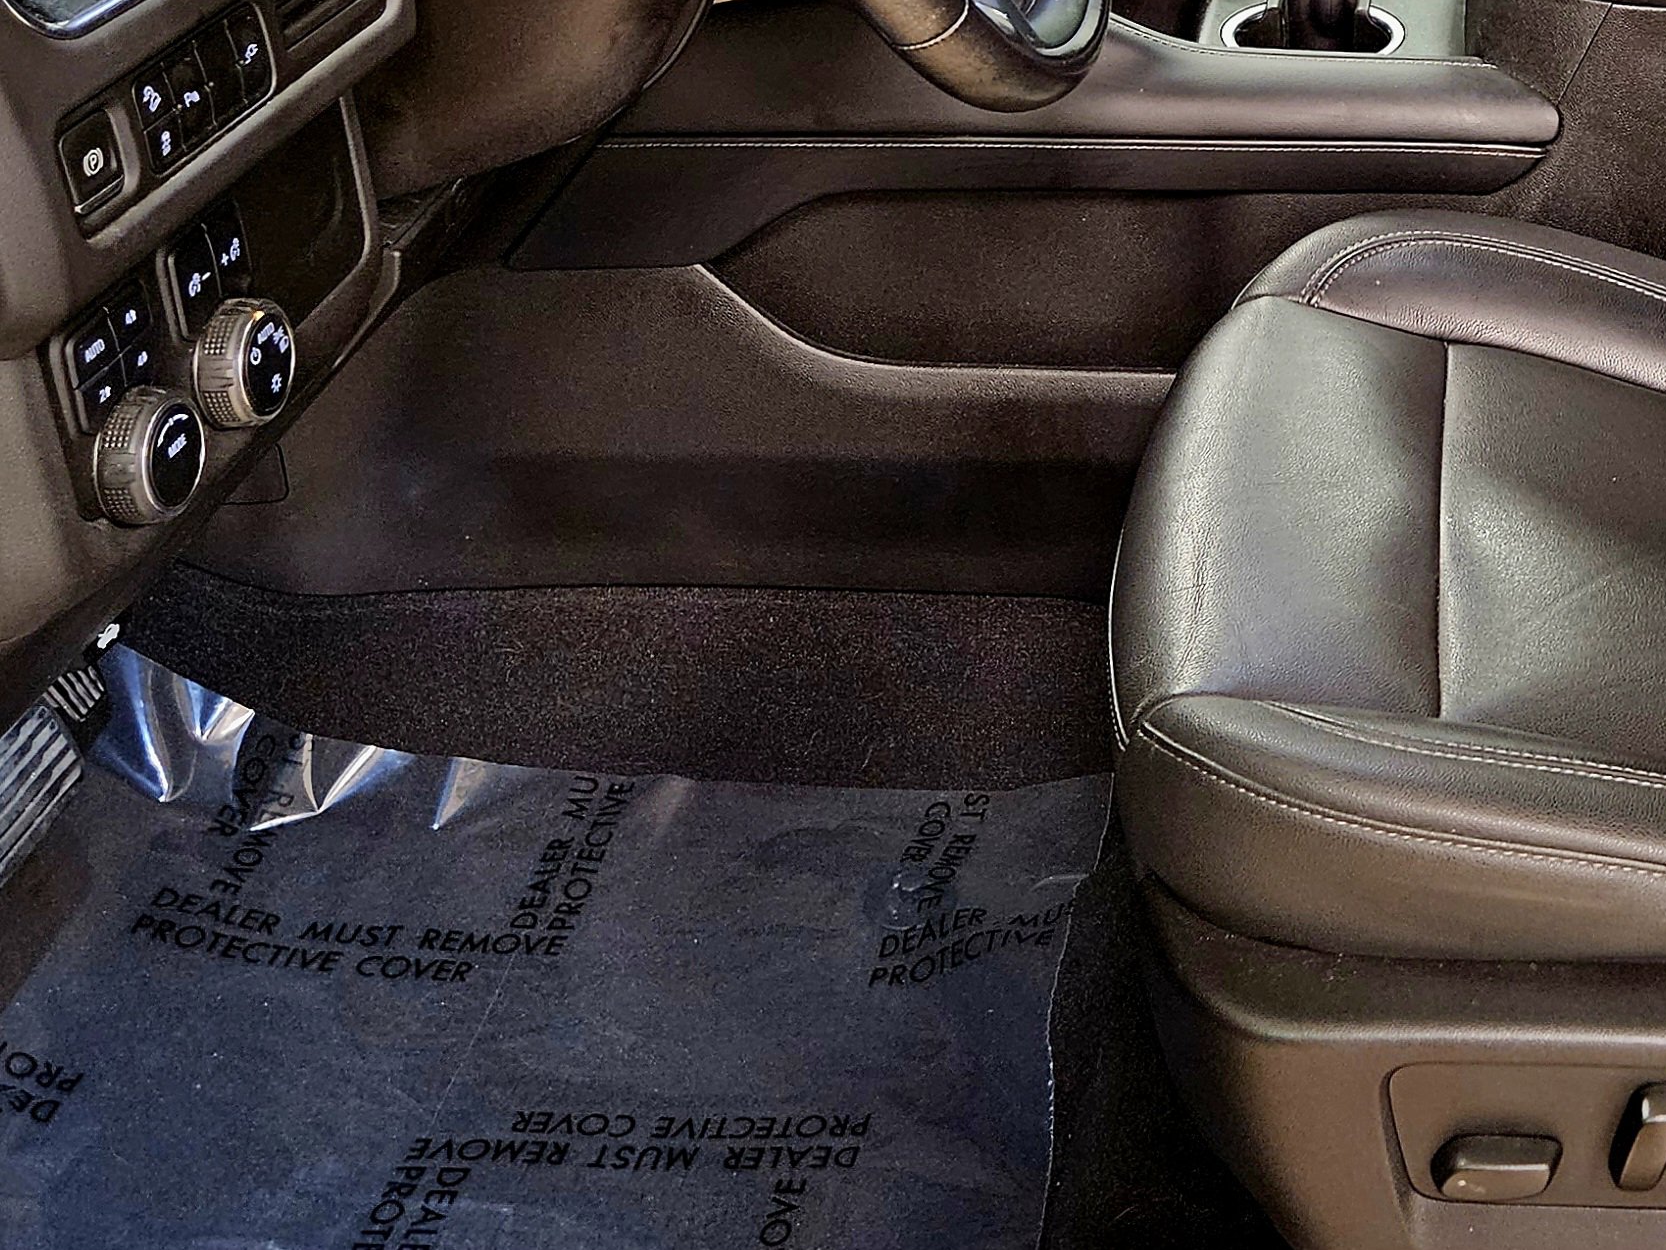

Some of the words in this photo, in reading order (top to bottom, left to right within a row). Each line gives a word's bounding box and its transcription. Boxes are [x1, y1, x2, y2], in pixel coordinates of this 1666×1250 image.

[84, 338, 106, 363] AUTO
[207, 733, 275, 837] COVER
[509, 836, 575, 930] DEALER
[562, 775, 600, 821] MU
[546, 781, 635, 931] PROTECTIVE
[900, 801, 950, 863] COVER
[916, 833, 977, 913] REMOVE
[130, 913, 343, 972] PROTECTIVE
[356, 955, 475, 982] COVER
[150, 886, 282, 936] DEALER
[299, 921, 404, 947] MUST
[418, 928, 569, 956] REMOVE
[878, 907, 987, 958] DEALER
[868, 928, 1055, 988] PROTECTIVE
[0, 1041, 84, 1092] PRO
[404, 1137, 571, 1165] REMOVE
[511, 1110, 636, 1138] COVER
[650, 1113, 872, 1140] PROTECTIVE
[587, 1144, 700, 1171] MUST
[723, 1146, 861, 1170] DEALER
